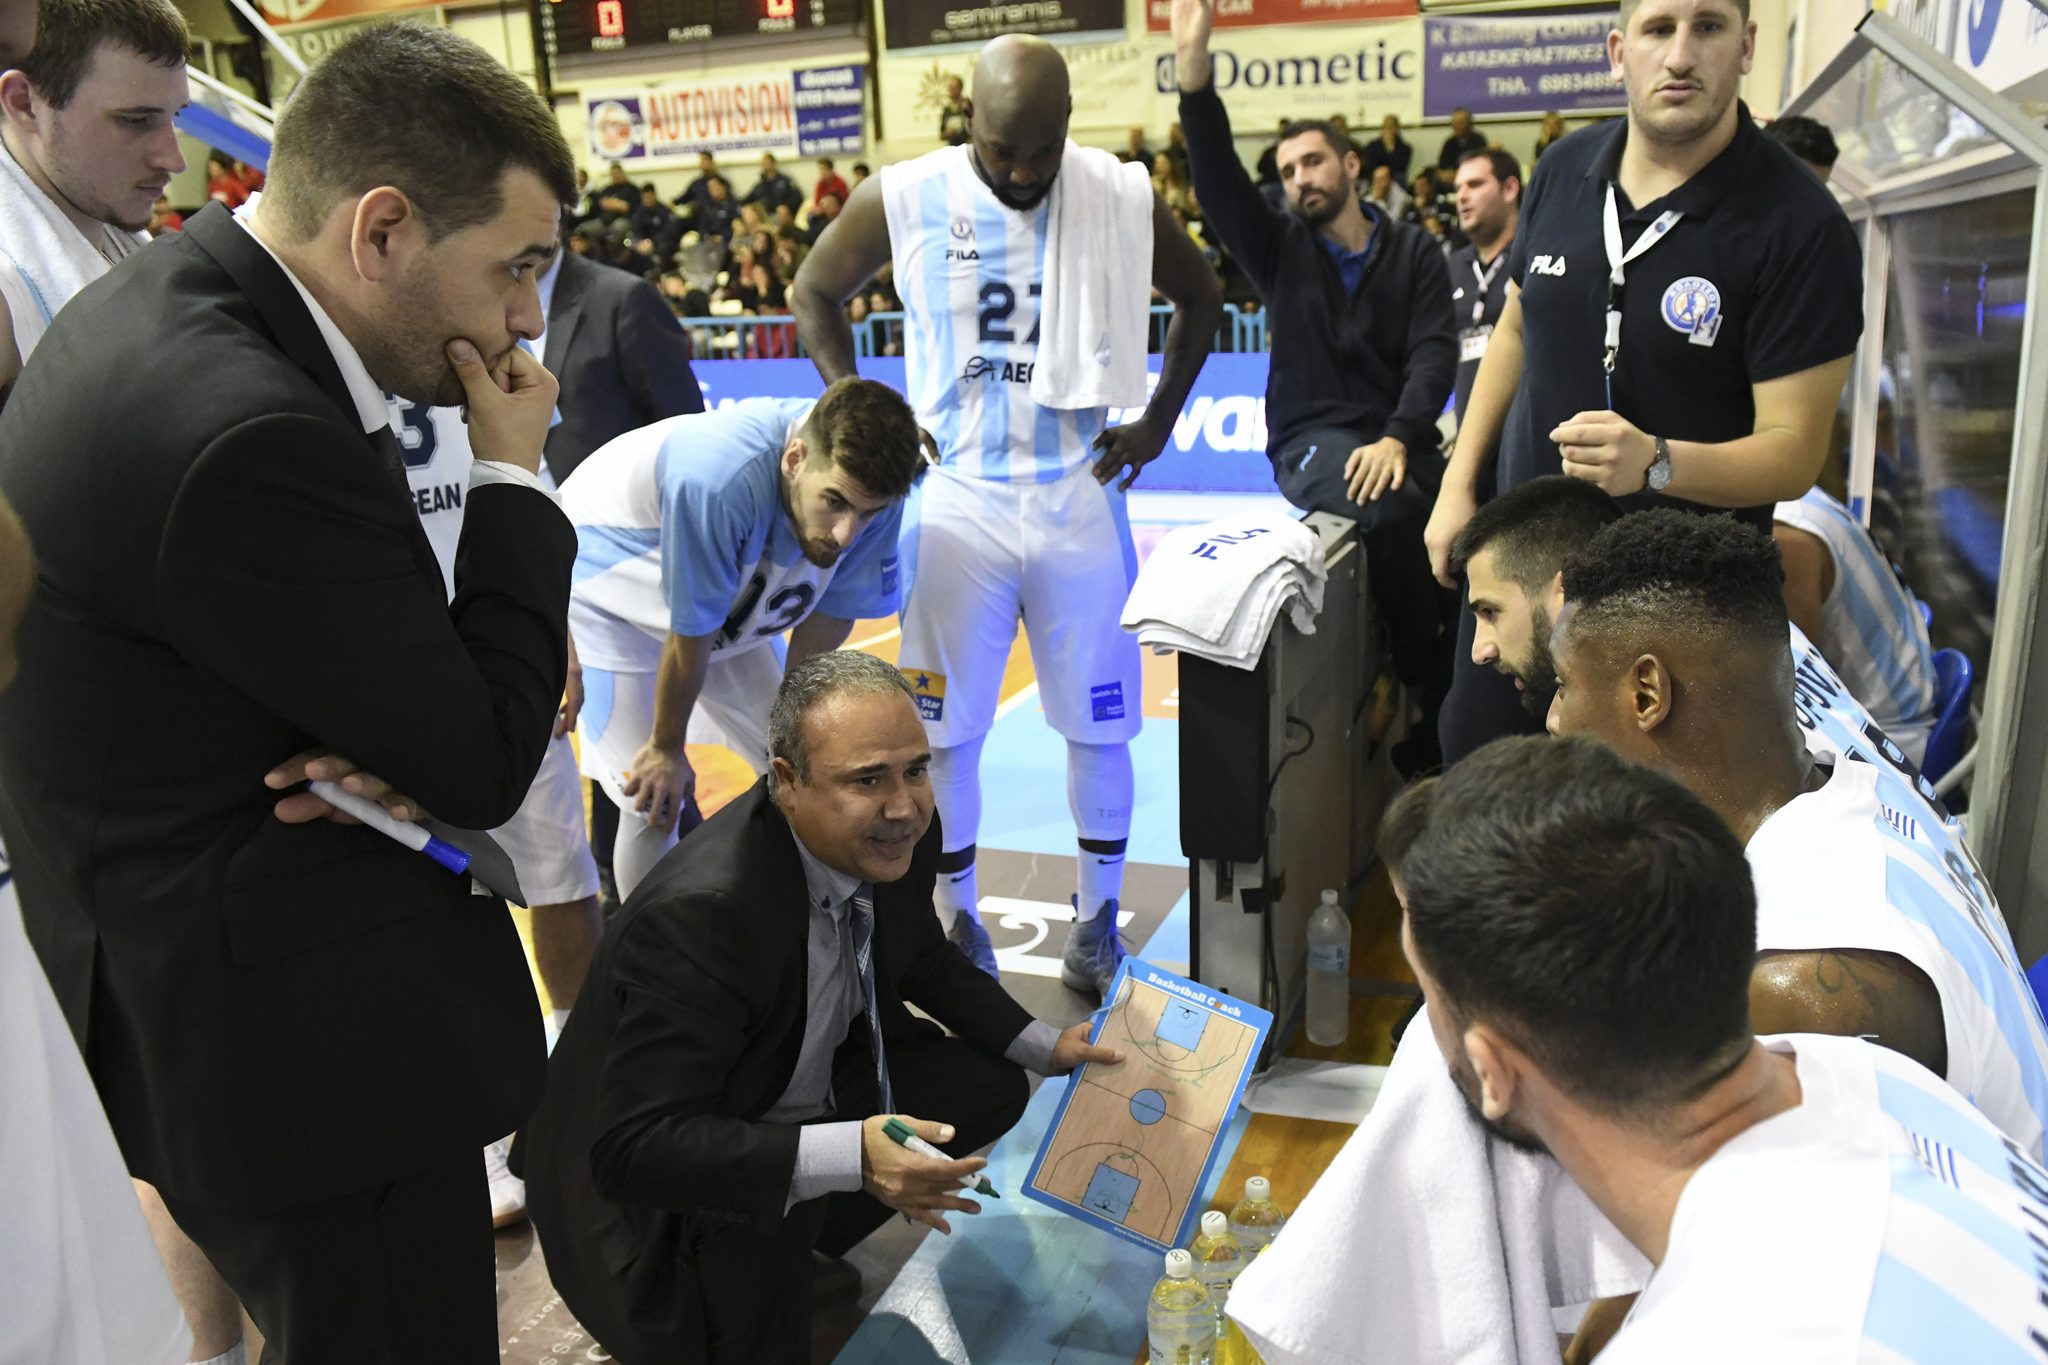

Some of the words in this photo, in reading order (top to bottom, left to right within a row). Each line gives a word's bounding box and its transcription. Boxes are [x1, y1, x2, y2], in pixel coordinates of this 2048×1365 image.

[1210, 40, 1415, 90] Dometic
[649, 80, 793, 141] AUTOVISION
[945, 249, 980, 260] FILA
[1529, 253, 1567, 277] FILA
[411, 482, 462, 516] EAN
[1147, 971, 1207, 1004] Basketball
